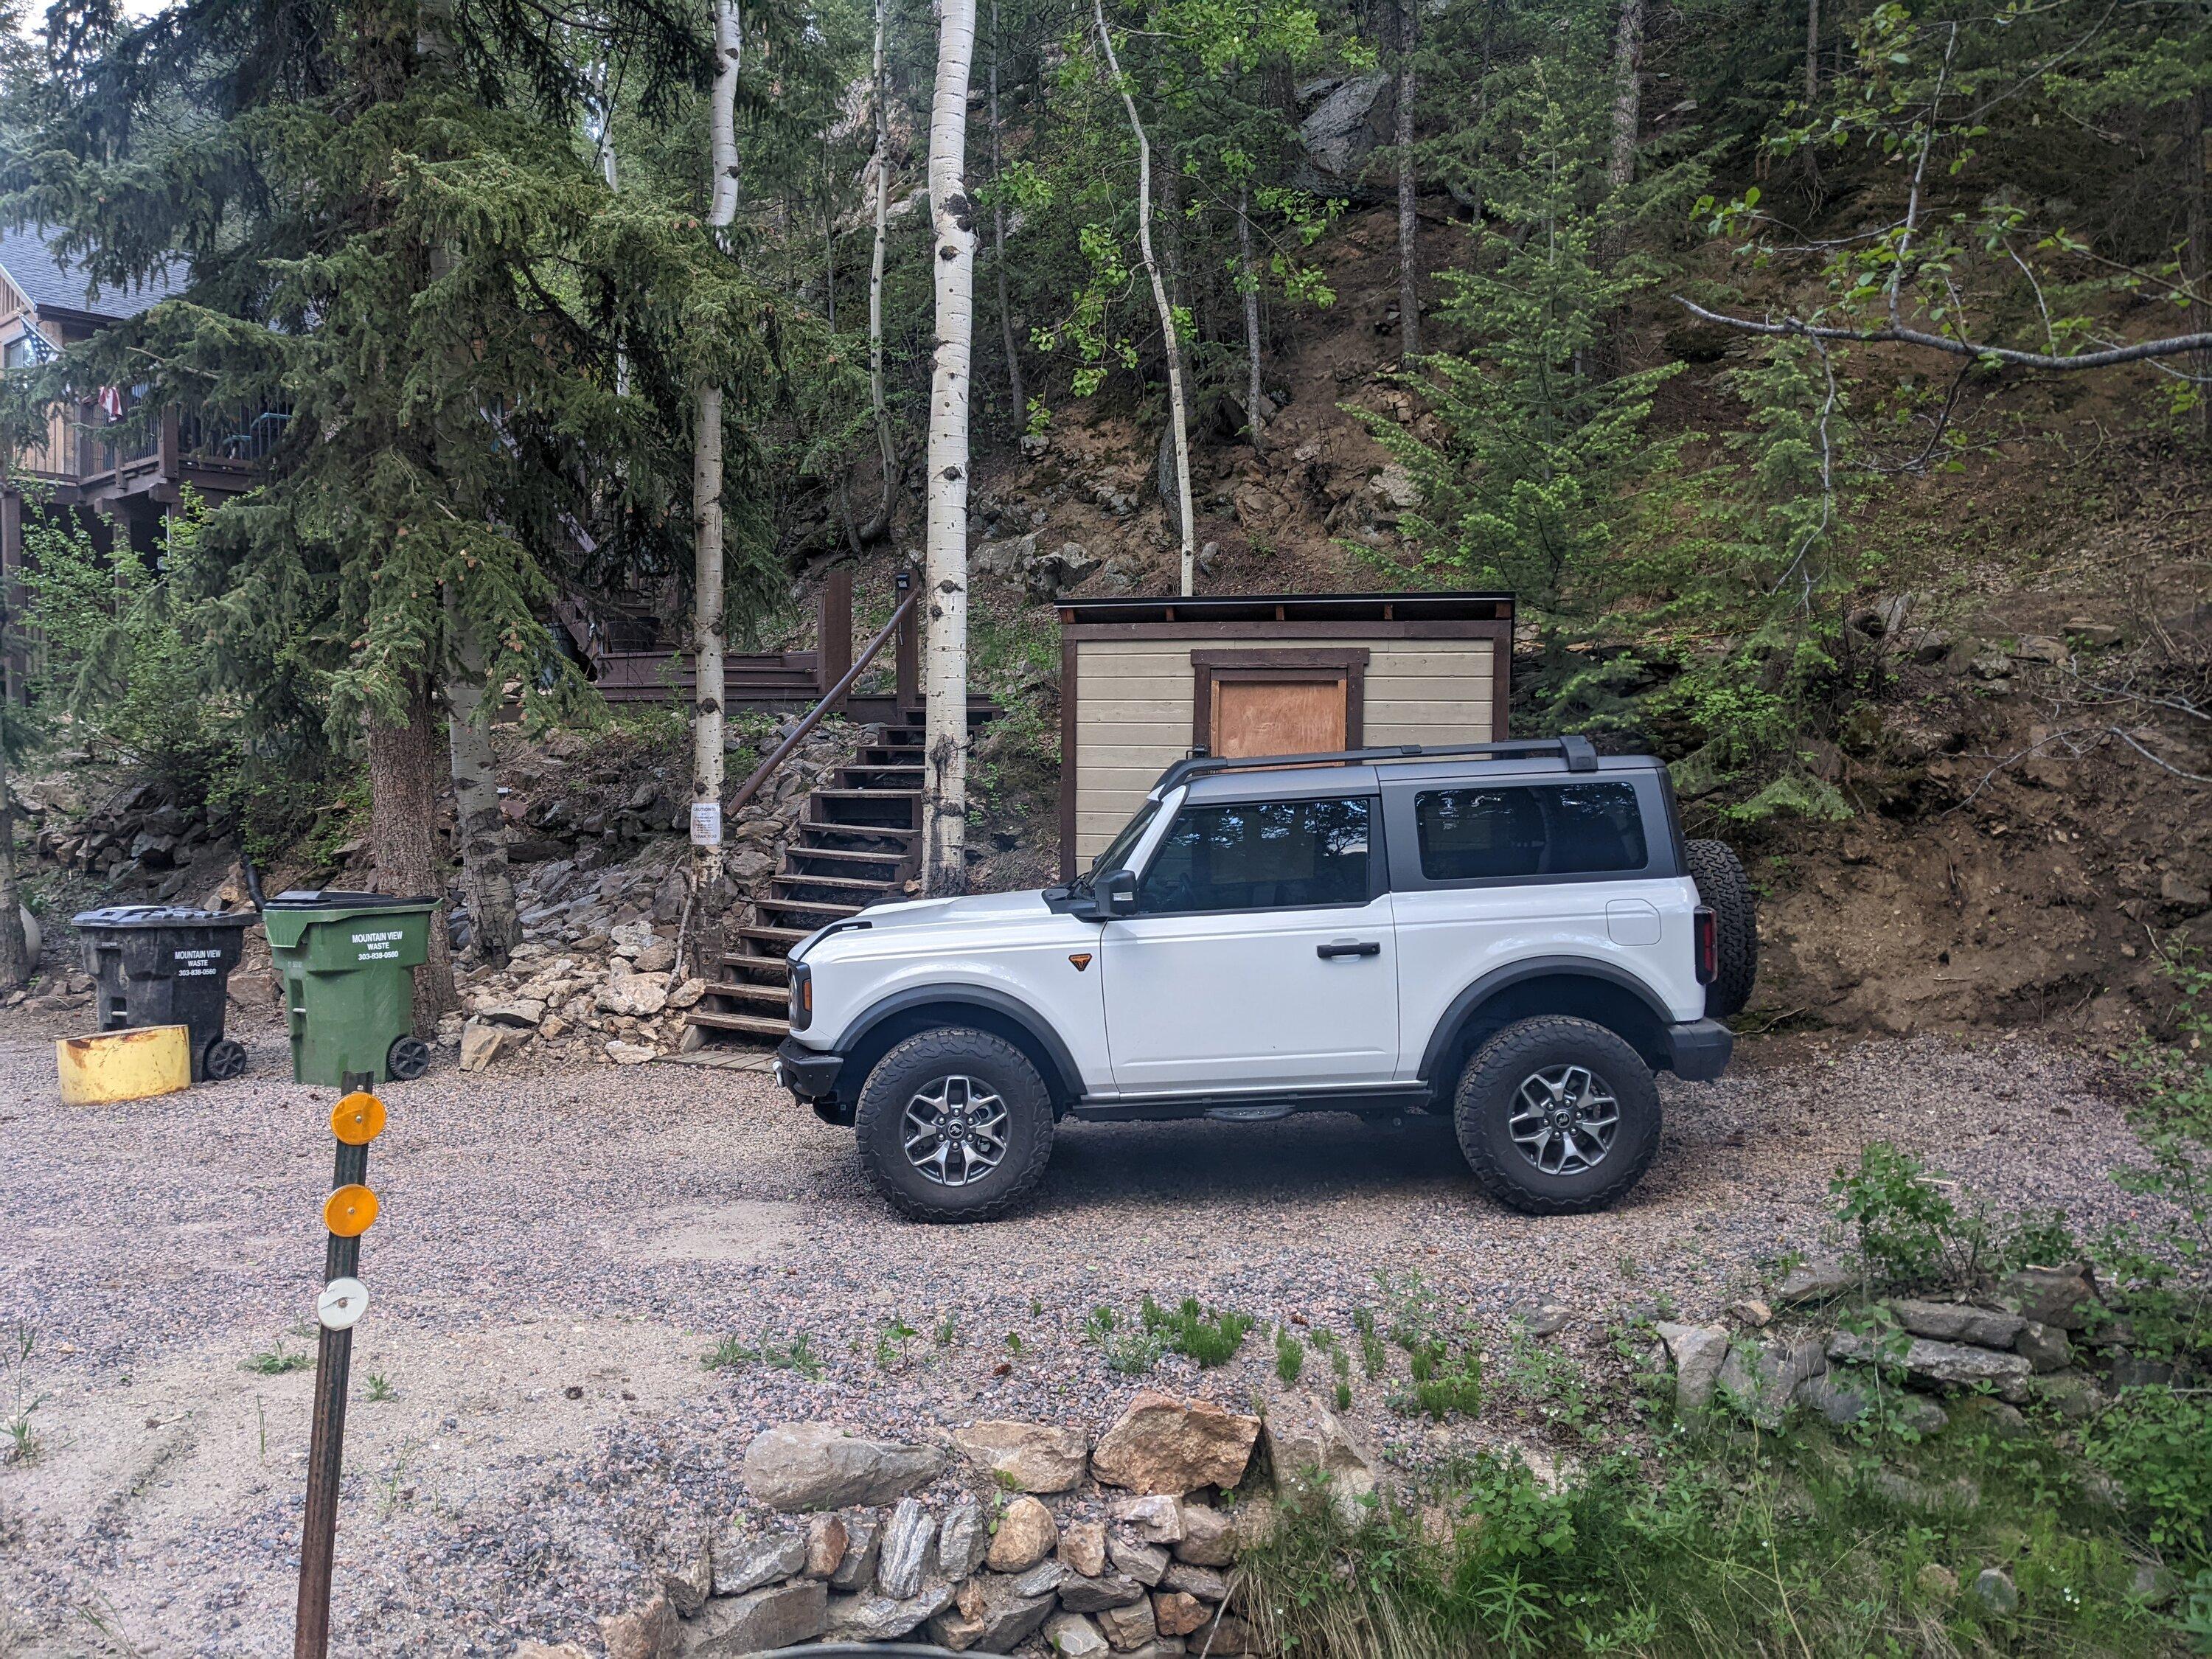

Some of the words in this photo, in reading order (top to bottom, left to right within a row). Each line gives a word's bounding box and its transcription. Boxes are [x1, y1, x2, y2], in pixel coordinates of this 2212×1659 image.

[352, 932, 387, 943] MOUNTAIN
[387, 931, 403, 940] VIEW
[367, 942, 390, 950] WASTE
[175, 950, 206, 959] MOUNTAIN
[206, 950, 221, 958] VIEW
[358, 950, 399, 961] 303-838-0560
[178, 968, 216, 976] 303-838-0560
